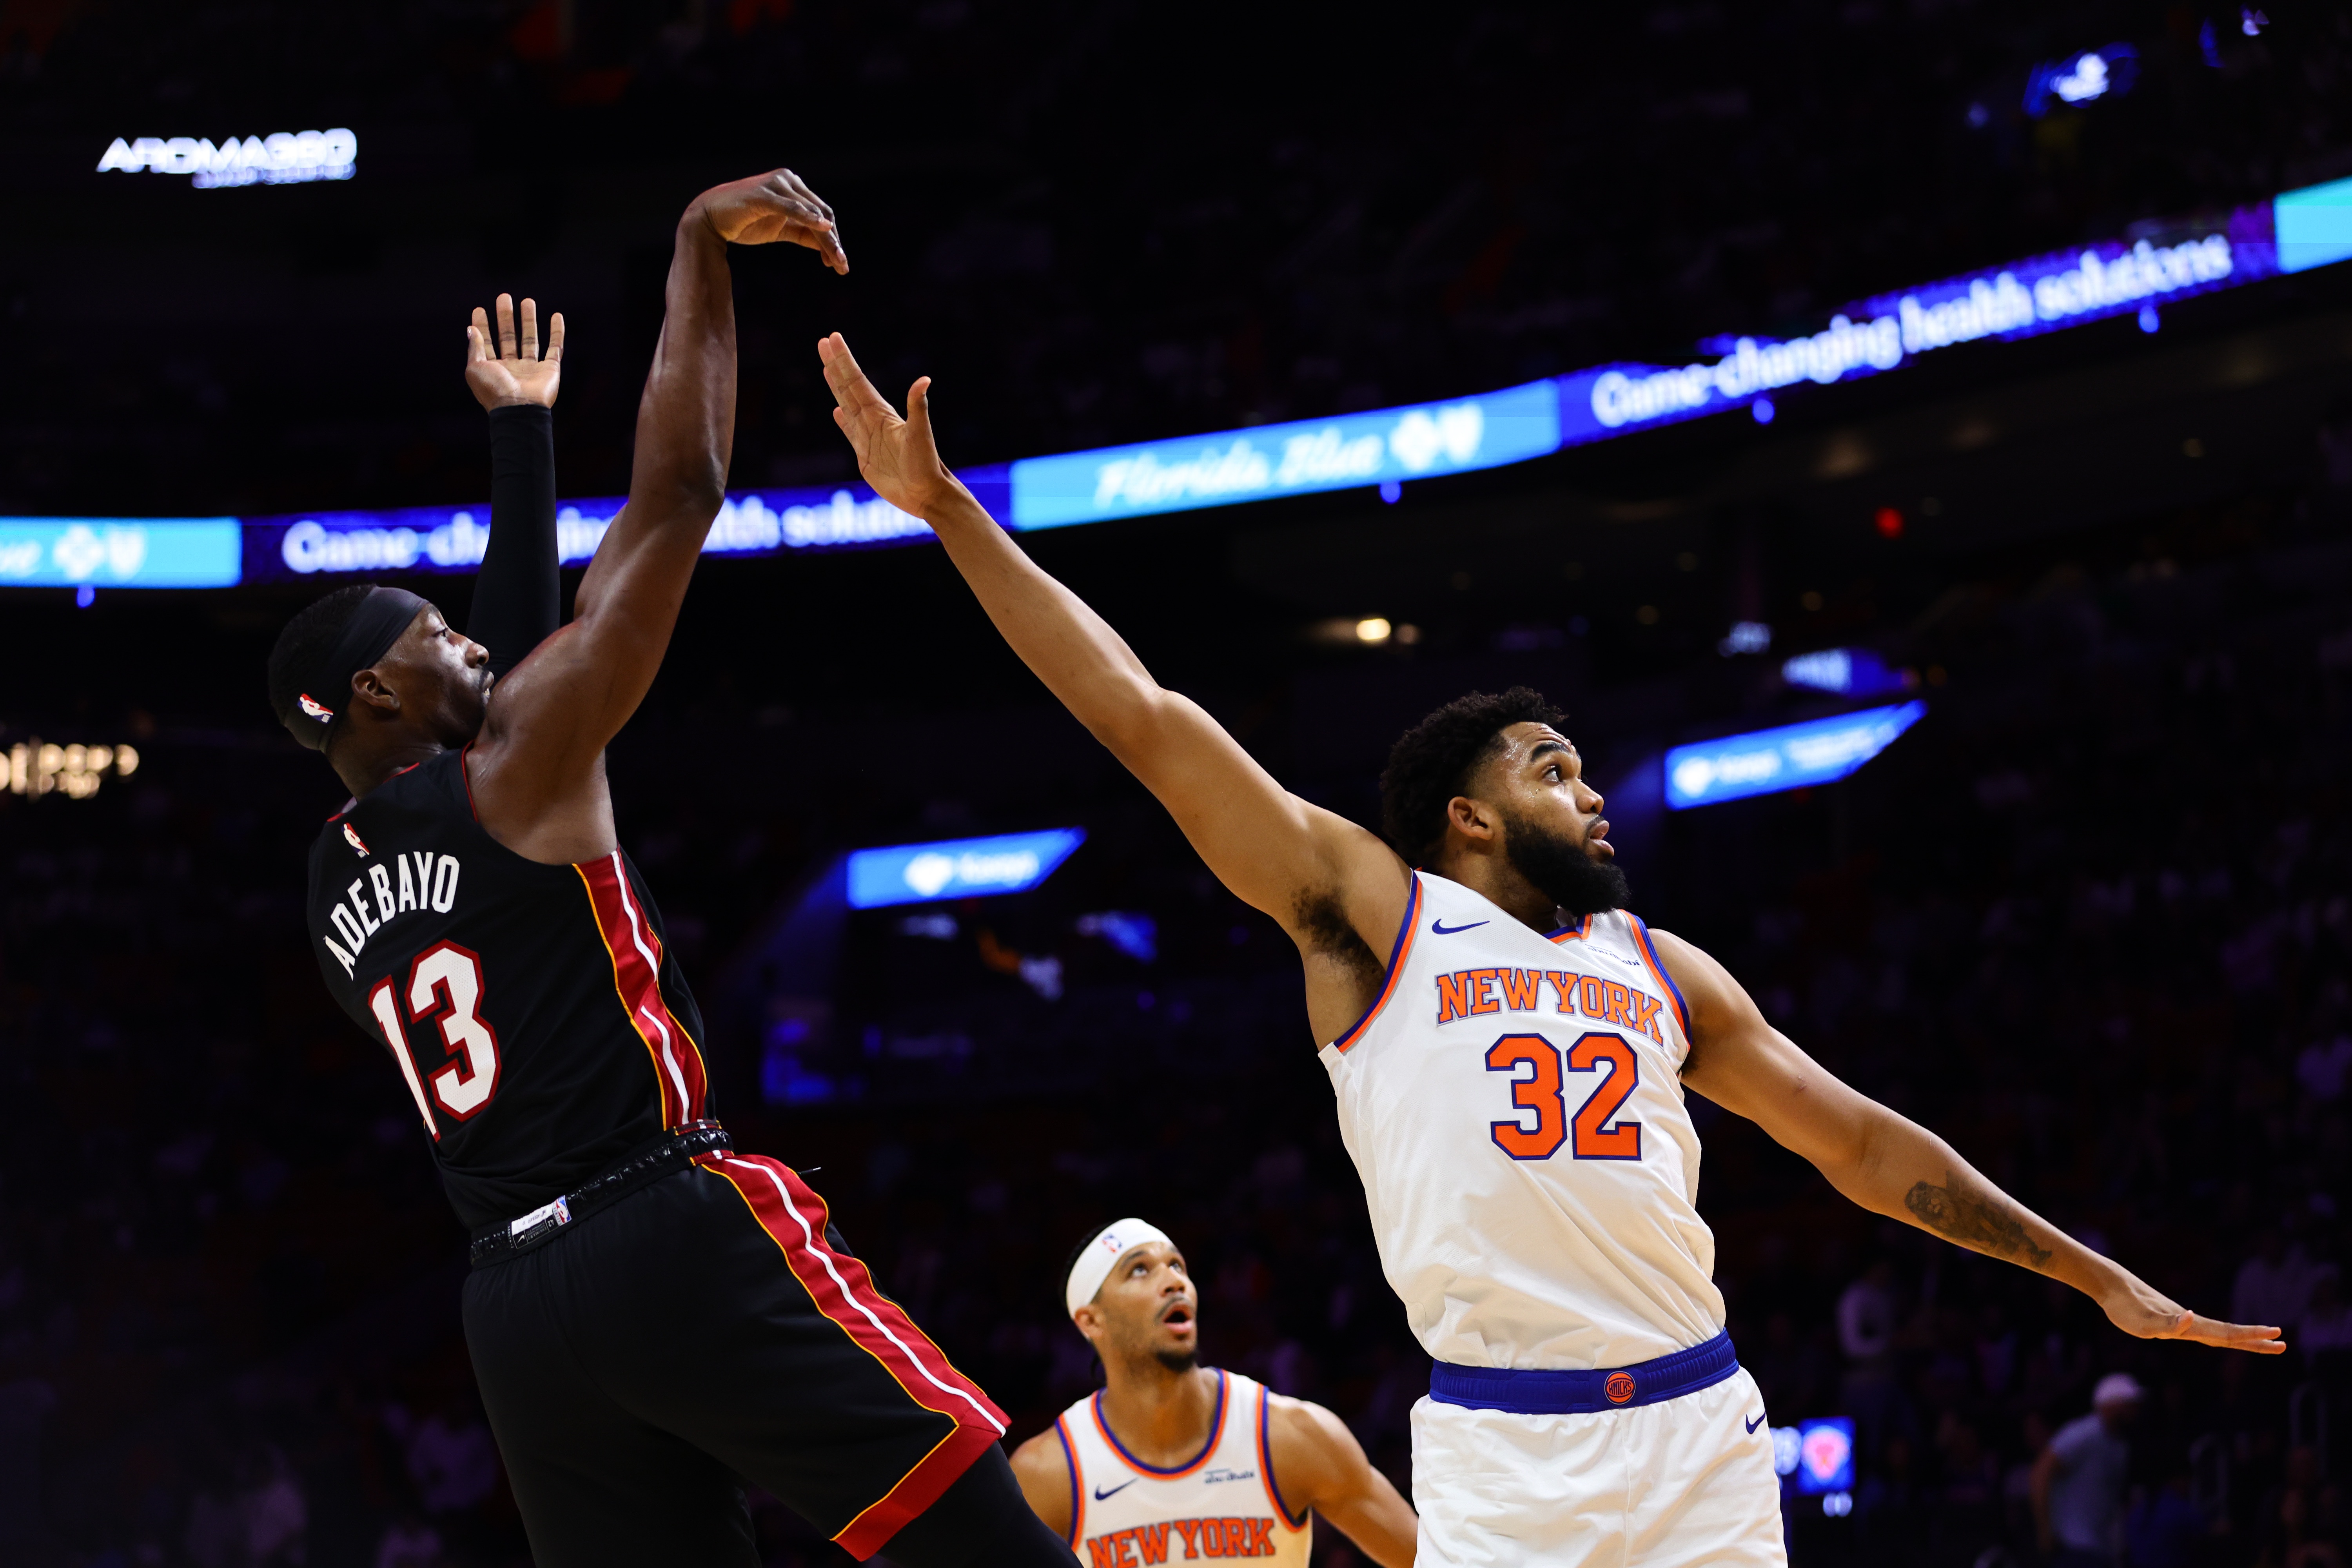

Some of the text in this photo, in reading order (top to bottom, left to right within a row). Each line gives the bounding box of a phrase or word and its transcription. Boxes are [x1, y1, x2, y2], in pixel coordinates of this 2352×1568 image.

[1902, 270, 2034, 354] health
[2033, 233, 2232, 320] solutions
[325, 851, 460, 980] ADEBAYO
[368, 938, 501, 1143] 13
[1435, 967, 1664, 1050] NEW YORK
[1485, 1032, 1642, 1161] 32
[548, 1219, 554, 1227] 42
[1608, 1380, 1632, 1396] KNICKS
[1086, 1517, 1276, 1568] NEW YORK
